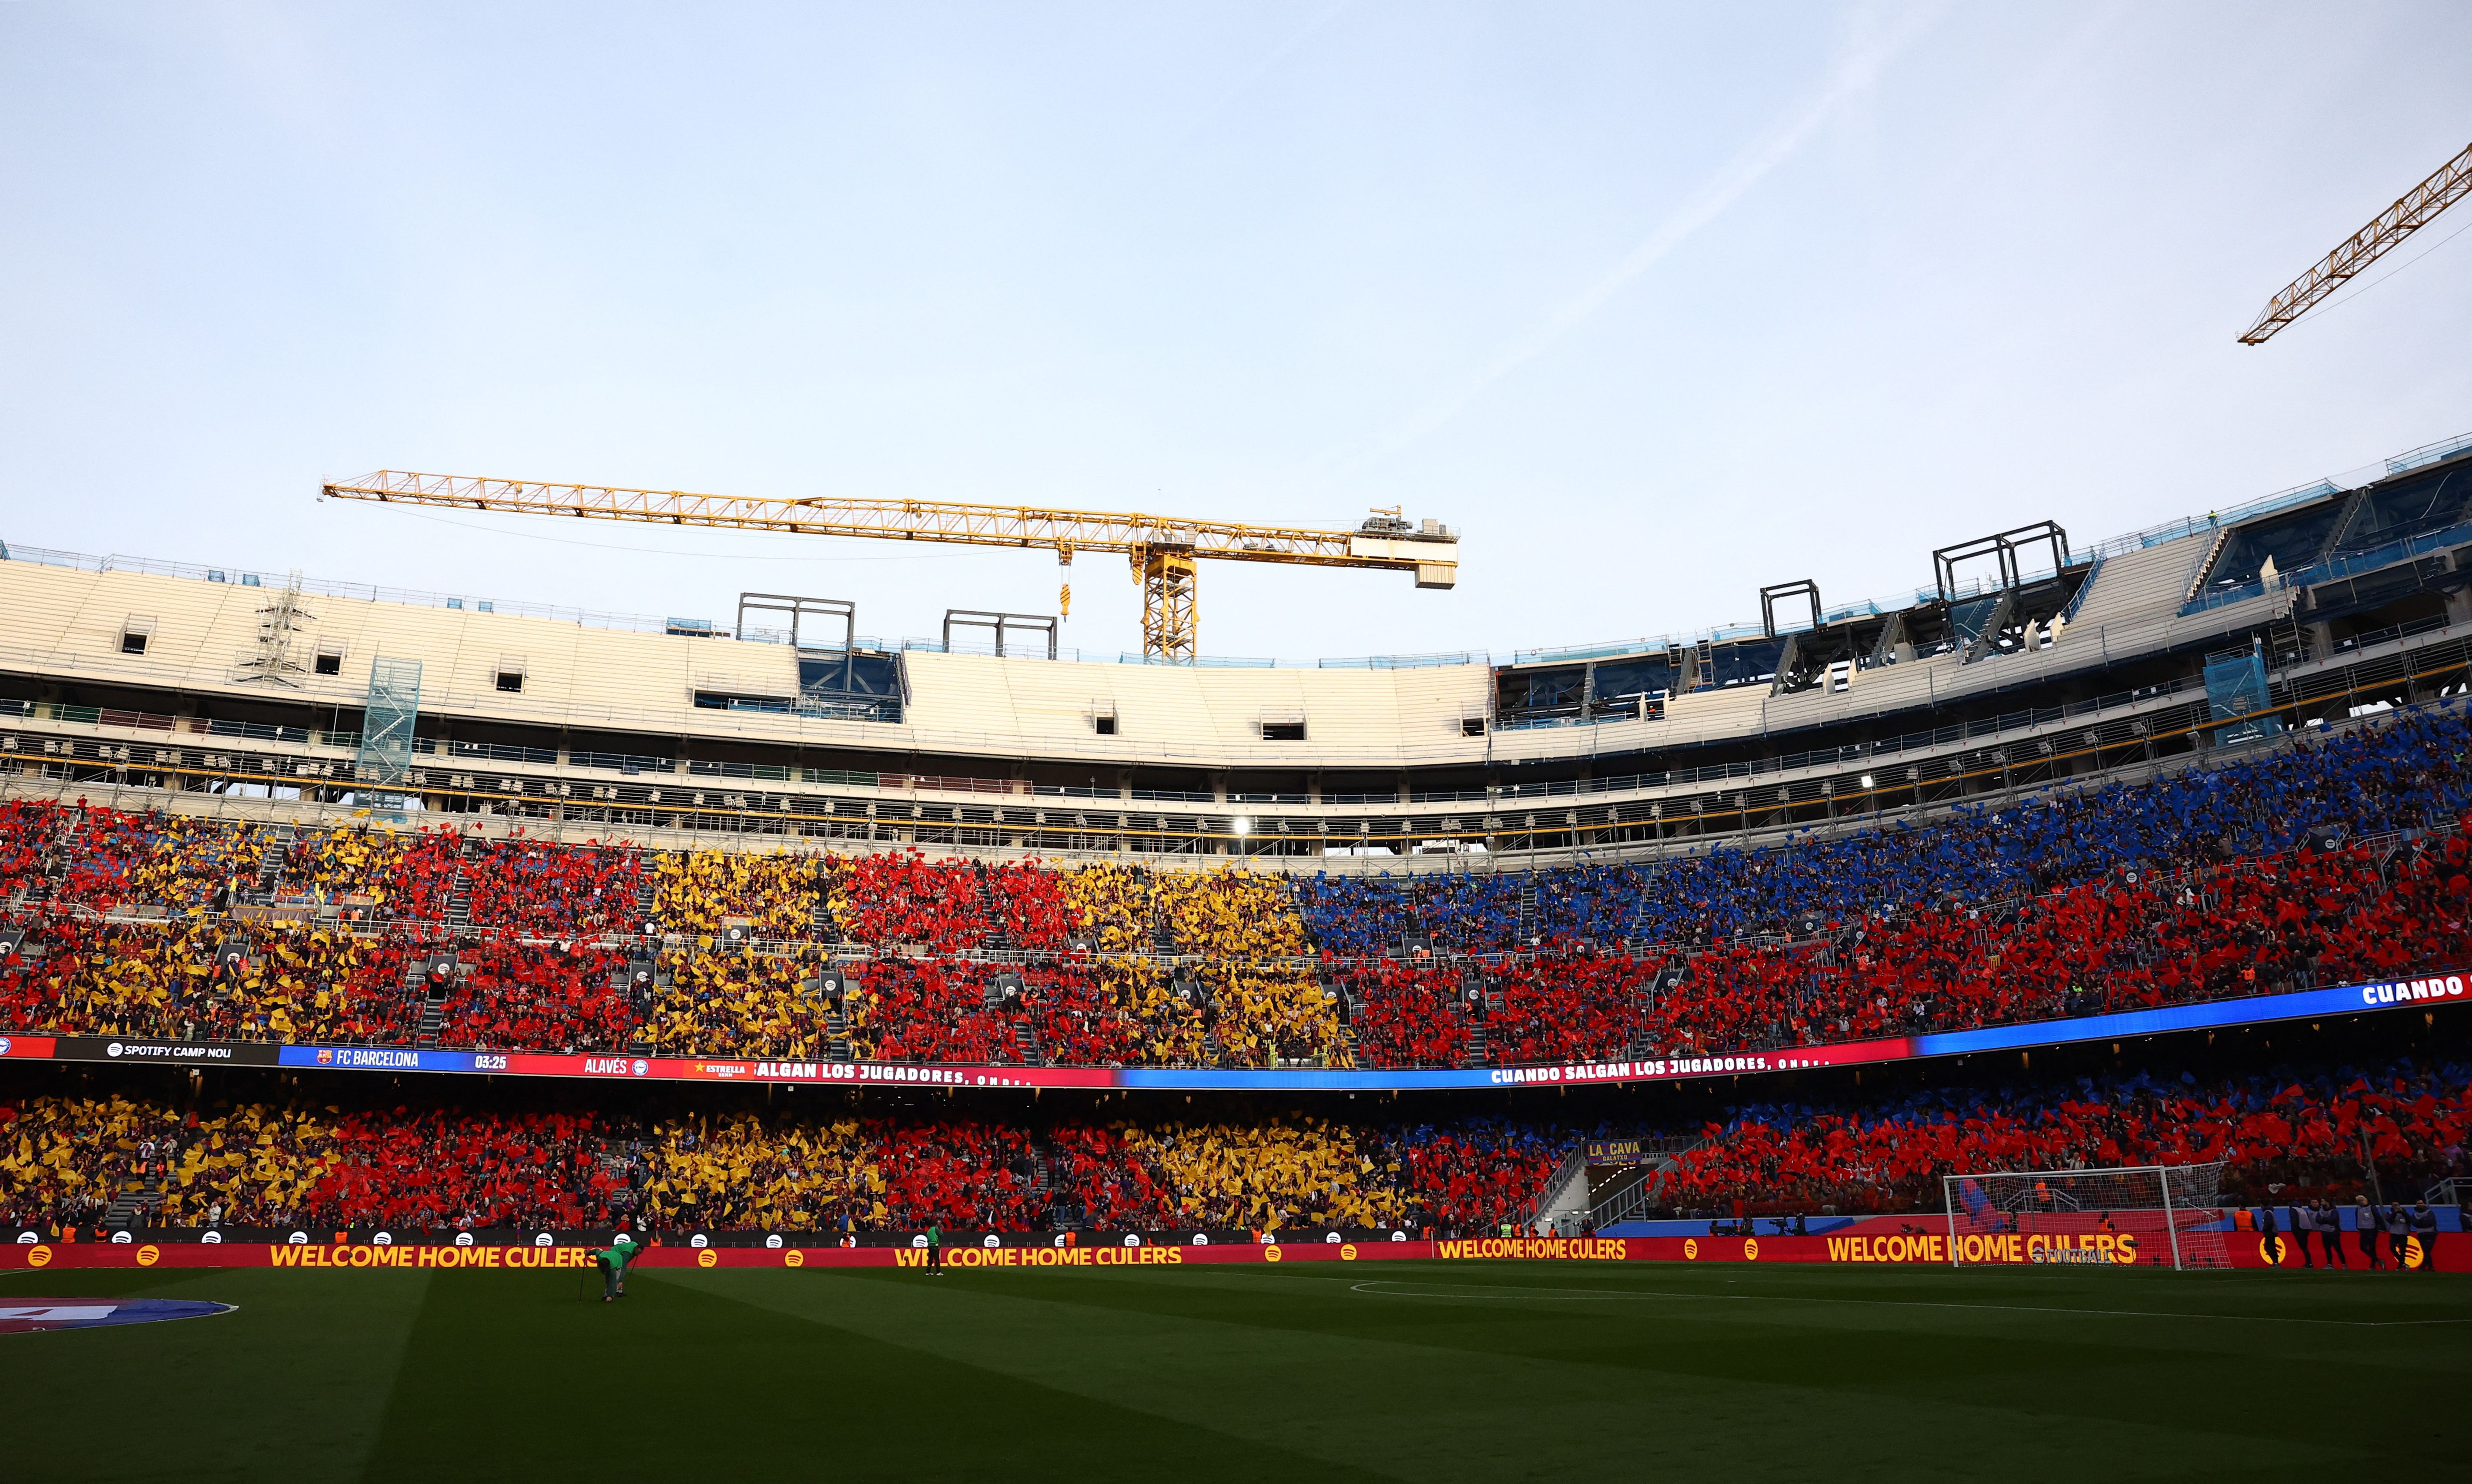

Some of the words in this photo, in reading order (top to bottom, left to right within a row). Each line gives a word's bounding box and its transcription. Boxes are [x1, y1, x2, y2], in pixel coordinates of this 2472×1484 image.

[2362, 976, 2463, 1004] CUANDO
[124, 1045, 172, 1056] SPOTIFY
[173, 1047, 206, 1057] CAMP
[207, 1048, 231, 1058] NOU
[337, 1050, 352, 1065] FC
[353, 1050, 418, 1067] BARCELONA
[475, 1055, 506, 1069] 03:25
[584, 1057, 626, 1074] ALAVÉS
[706, 1065, 745, 1073] ESTRELLA
[1491, 1067, 1560, 1083] CUANDO
[1564, 1062, 1630, 1079] SALGAN
[1635, 1061, 1665, 1075] LOS
[1670, 1057, 1771, 1074] JUGADORES,
[754, 1062, 817, 1078] ALGAN
[822, 1064, 854, 1079] LOS
[859, 1065, 969, 1085] JUGADORES,
[1589, 1145, 1603, 1156] LA
[1610, 1142, 1640, 1155] CAVA
[270, 1245, 414, 1267] WELCOME
[418, 1246, 501, 1267] HOME
[1022, 1248, 1092, 1266] HOME
[1096, 1246, 1182, 1265] CULERS
[1439, 1239, 1524, 1259] WELCOME
[1526, 1239, 1567, 1258] HOME
[1569, 1239, 1626, 1260] CULERS
[1827, 1236, 1943, 1262] WELCOME
[1946, 1235, 2023, 1262] HOME
[2027, 1234, 2137, 1263] CULERS
